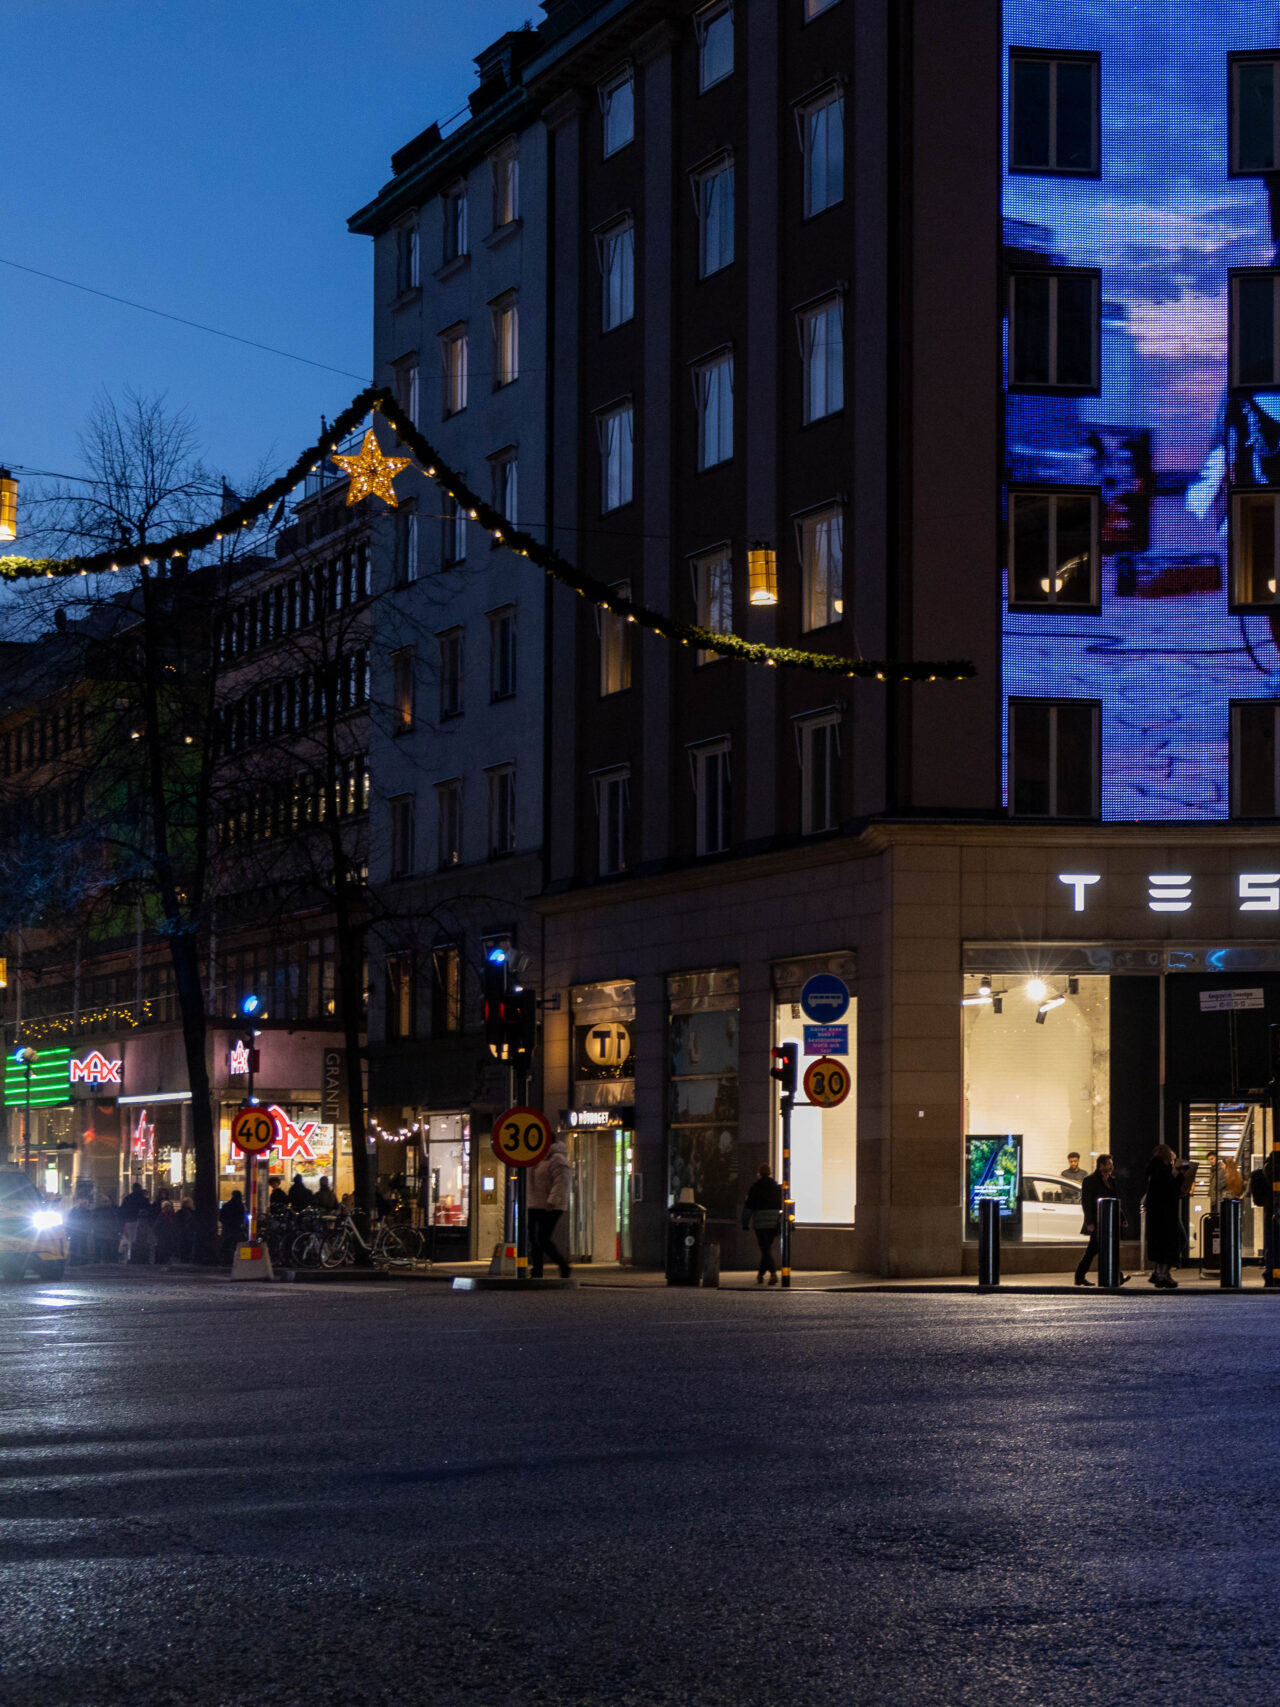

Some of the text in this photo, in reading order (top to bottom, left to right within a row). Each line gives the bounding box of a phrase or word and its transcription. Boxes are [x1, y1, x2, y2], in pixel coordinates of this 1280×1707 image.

[70, 1050, 122, 1083] MAX
[326, 1052, 340, 1118] GRANIT
[811, 1071, 845, 1096] 30
[238, 1120, 270, 1143] 40
[503, 1123, 543, 1152] 30
